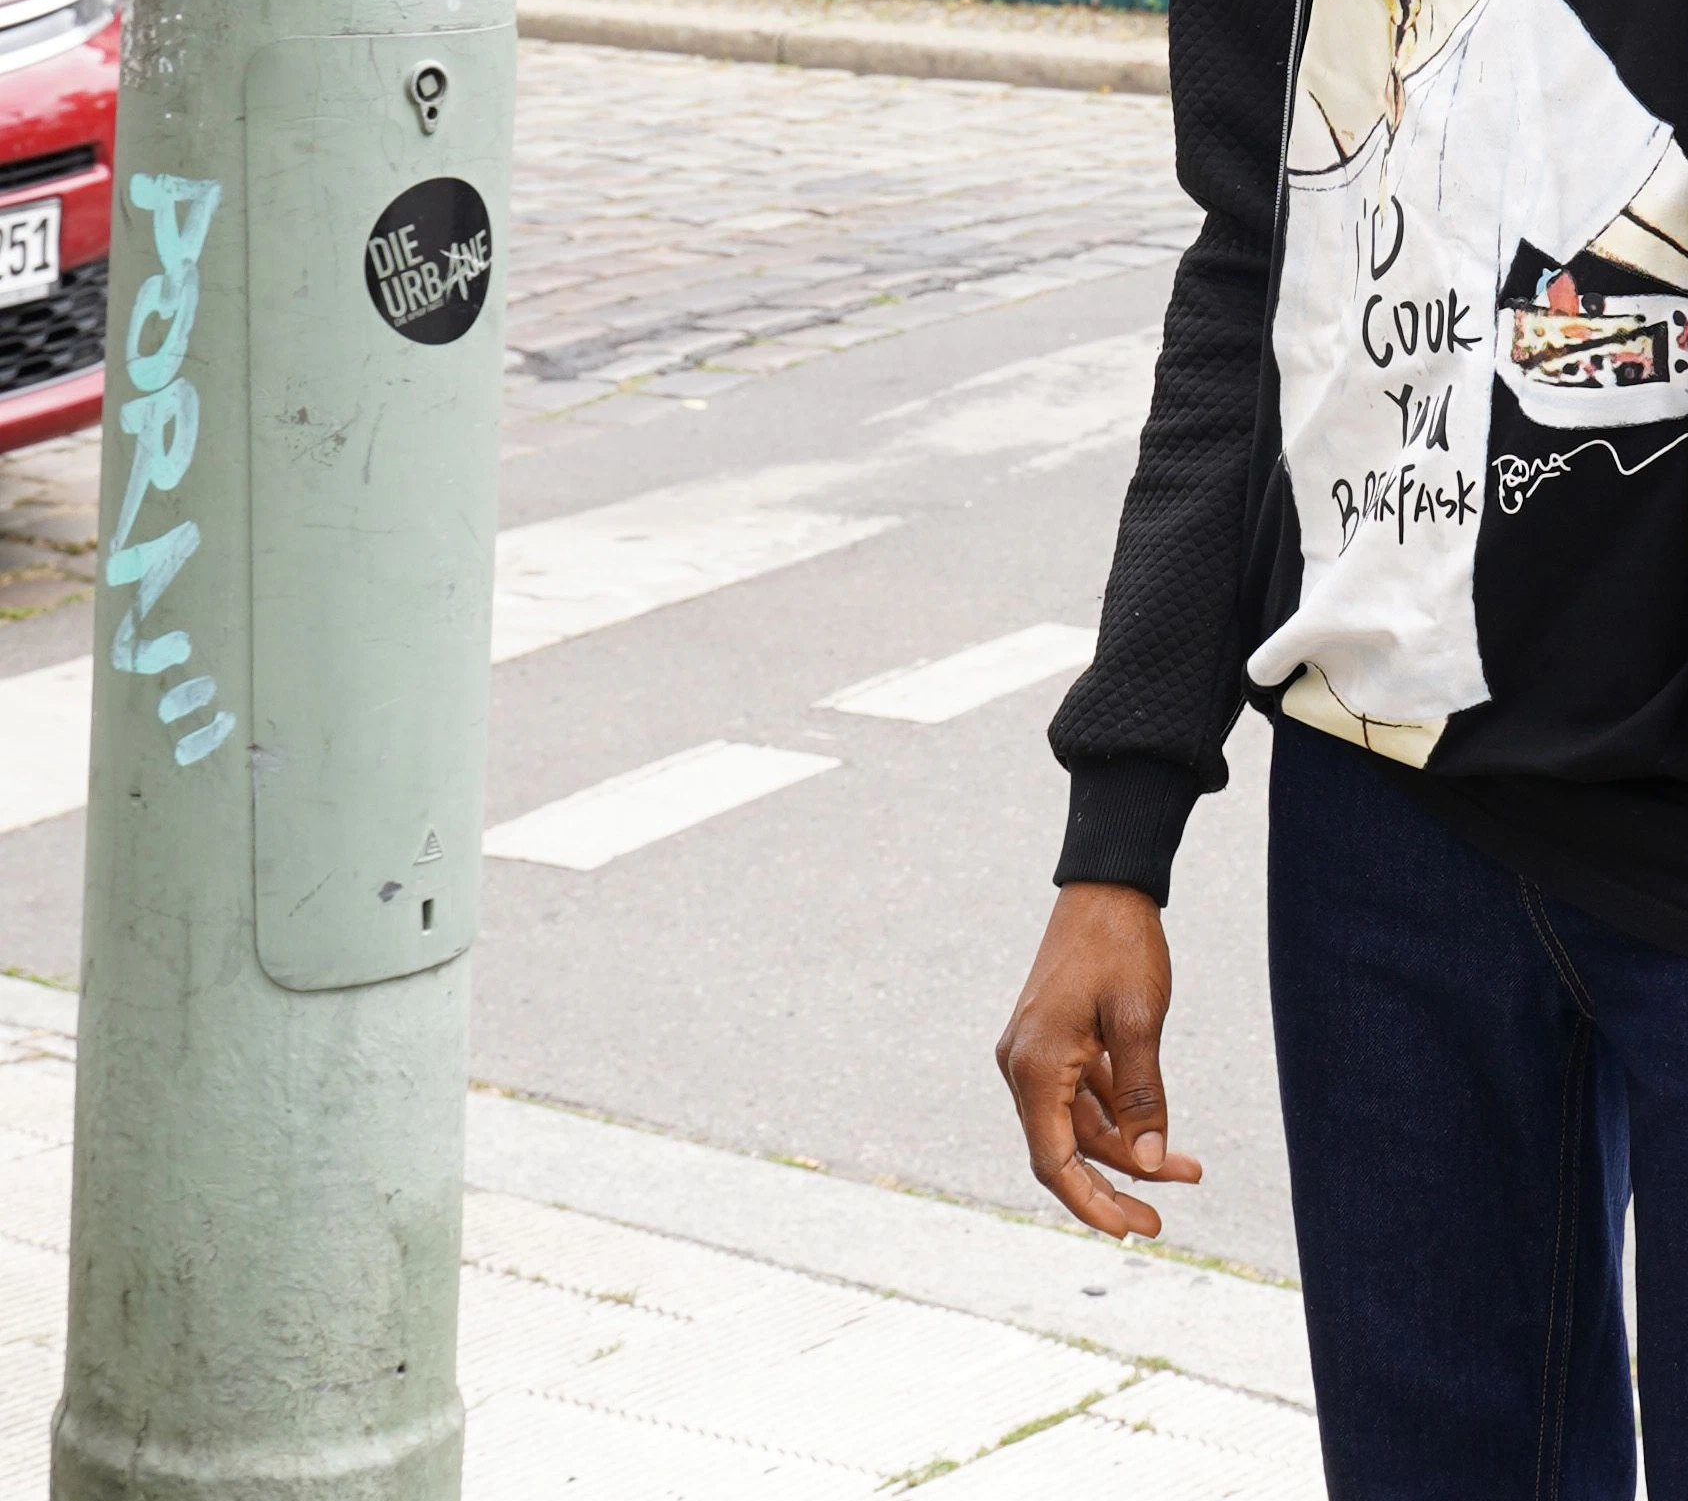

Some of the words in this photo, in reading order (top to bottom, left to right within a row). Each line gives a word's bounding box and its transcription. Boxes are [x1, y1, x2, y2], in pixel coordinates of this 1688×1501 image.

[0, 218, 50, 280] 51
[367, 223, 425, 280] DIE
[380, 229, 489, 318] URBANE
